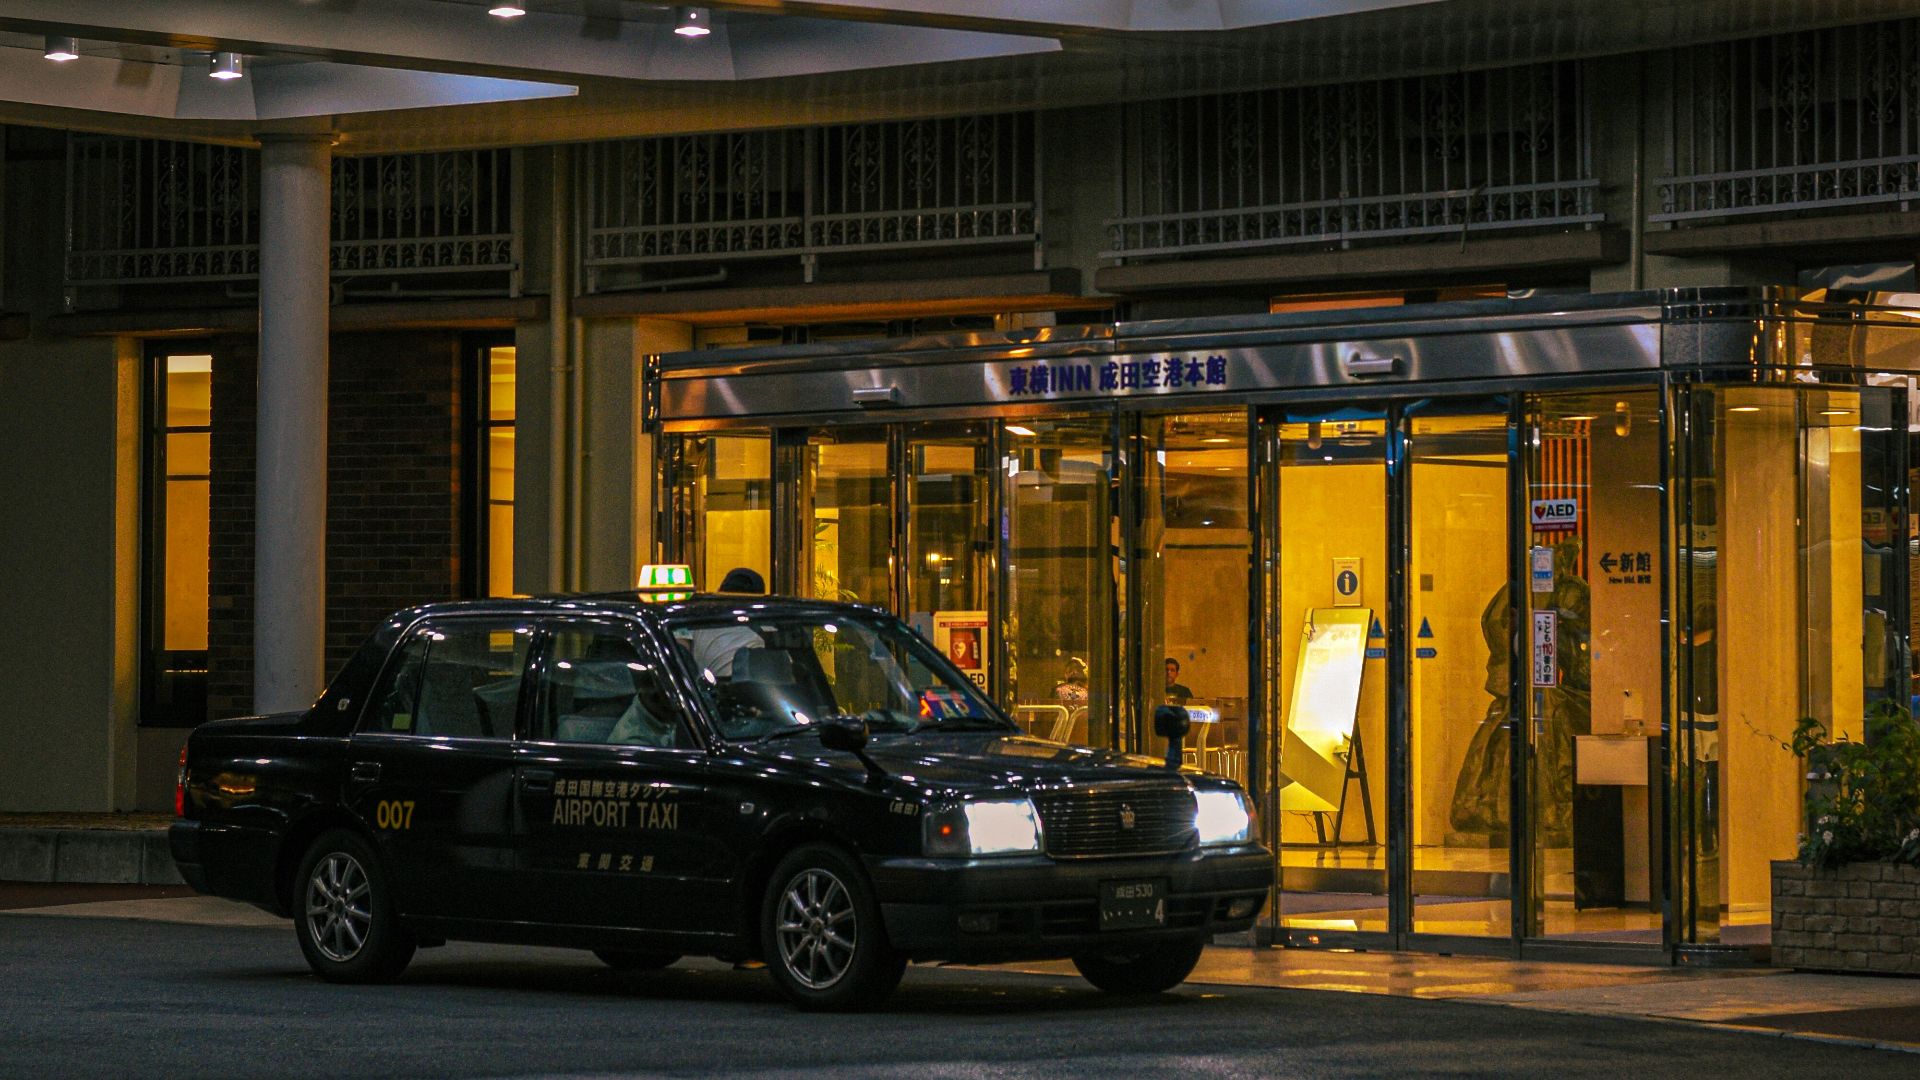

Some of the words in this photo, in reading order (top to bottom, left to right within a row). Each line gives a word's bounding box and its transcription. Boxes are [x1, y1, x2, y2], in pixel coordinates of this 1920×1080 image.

[1009, 363, 1092, 396] 東横INN
[1099, 355, 1228, 392] 成田空港本館
[1546, 503, 1575, 516] AED
[1620, 552, 1651, 572] 新館
[377, 800, 415, 830] 007
[553, 798, 631, 827] AIRPORT
[637, 801, 678, 830] TAXI
